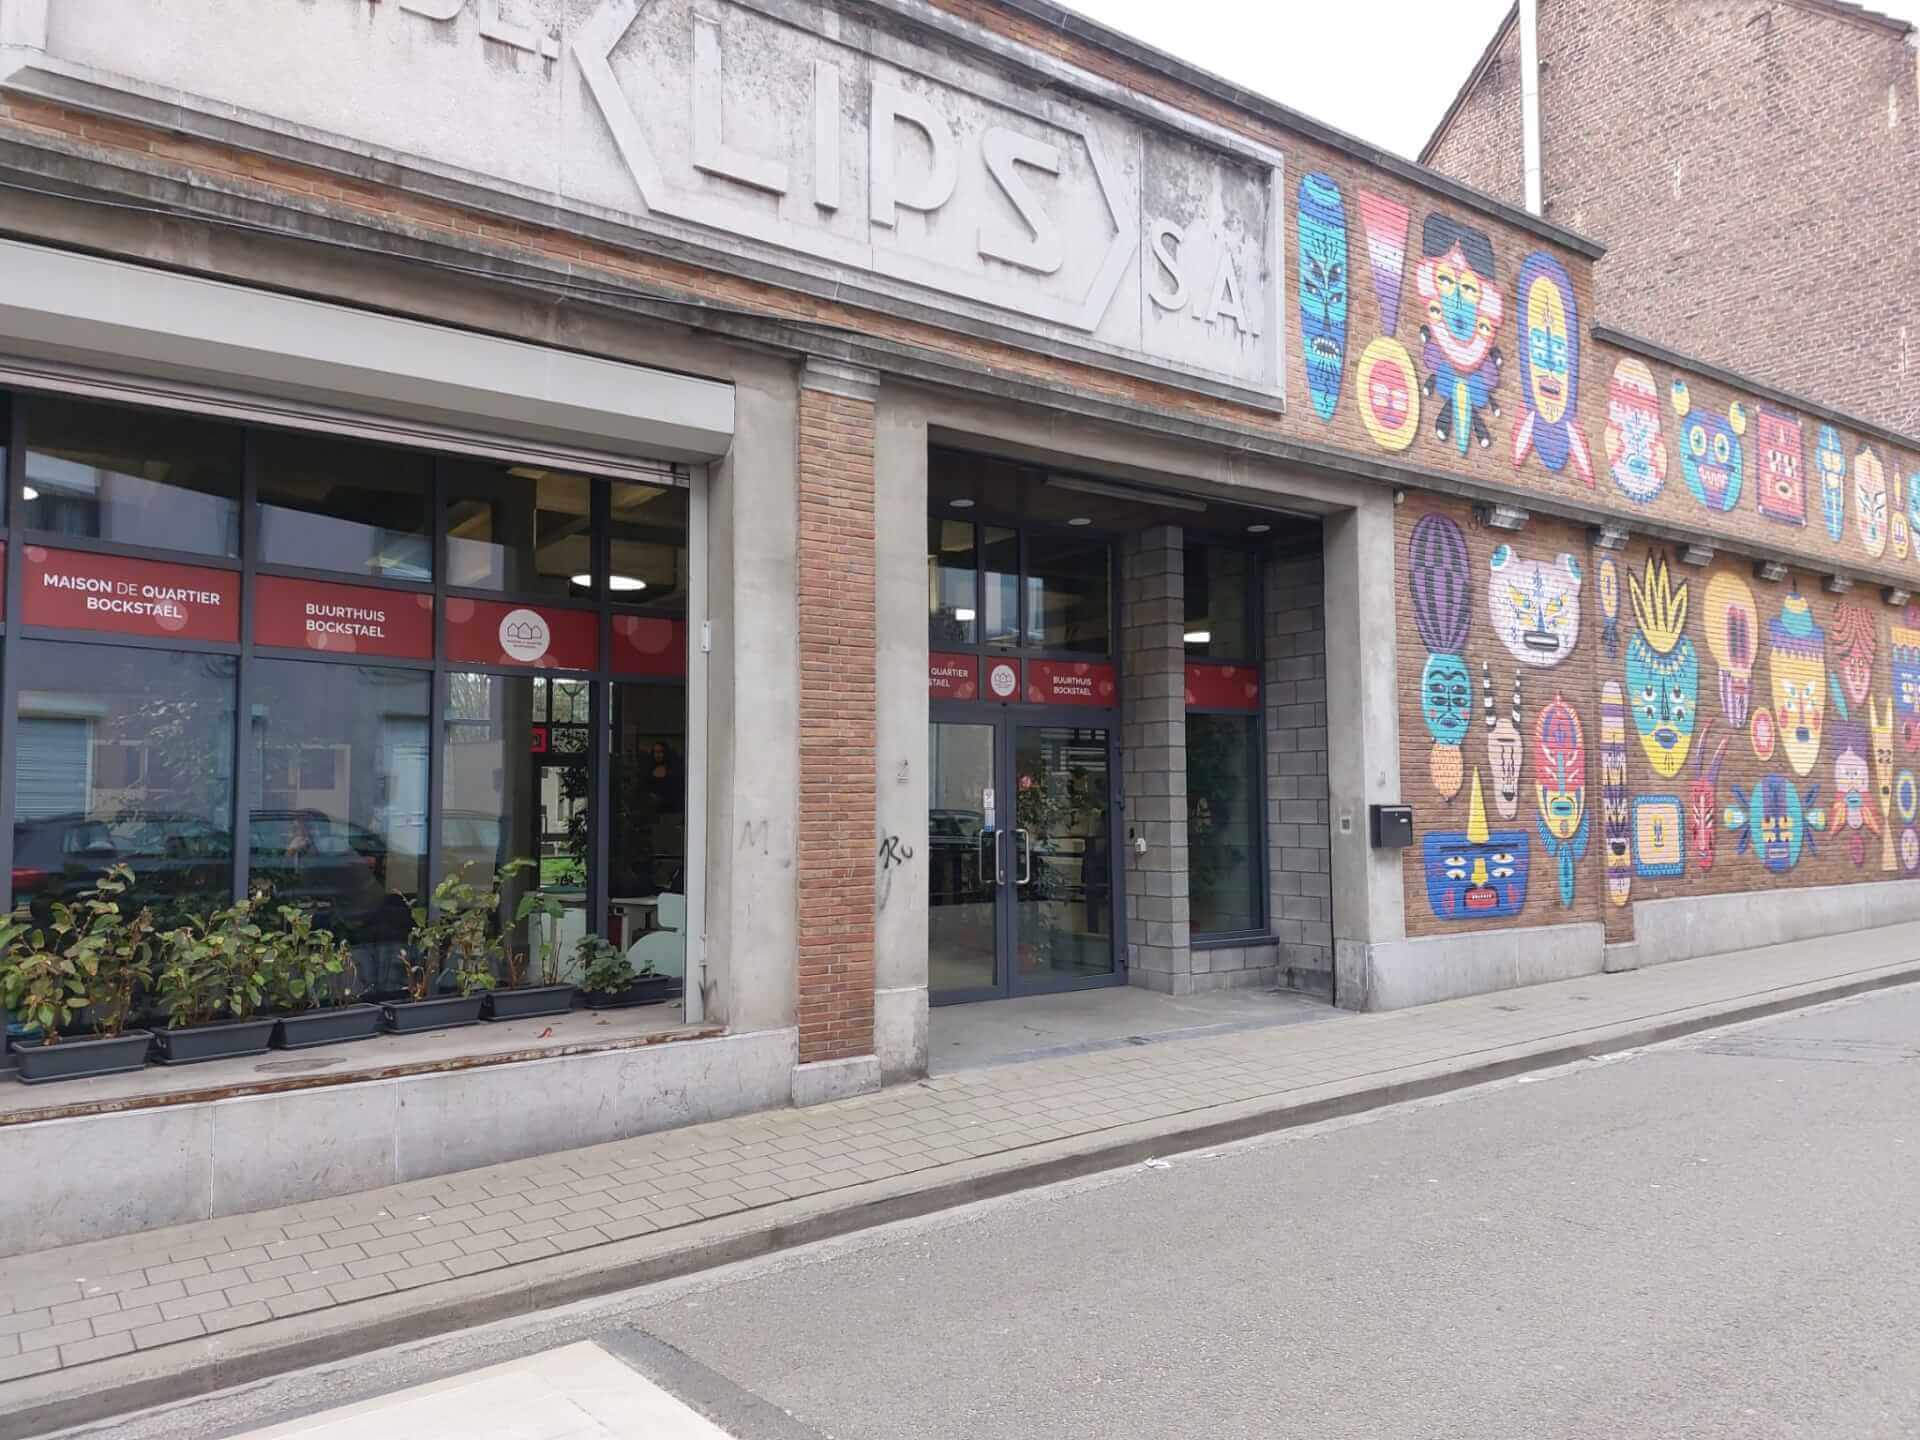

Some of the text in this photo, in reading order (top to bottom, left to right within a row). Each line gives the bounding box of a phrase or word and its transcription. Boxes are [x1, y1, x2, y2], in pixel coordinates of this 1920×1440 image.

[43, 573, 221, 606] MAISON DE QUARTIER
[86, 596, 183, 619] BOCKSTAEL
[305, 602, 386, 623] BUURTHUIS
[305, 619, 385, 638] BOCKSTAEL
[930, 667, 969, 679] QUARTIER
[1053, 675, 1092, 686] BUURTHUIS
[1053, 686, 1092, 696] BOCKSTAEL
